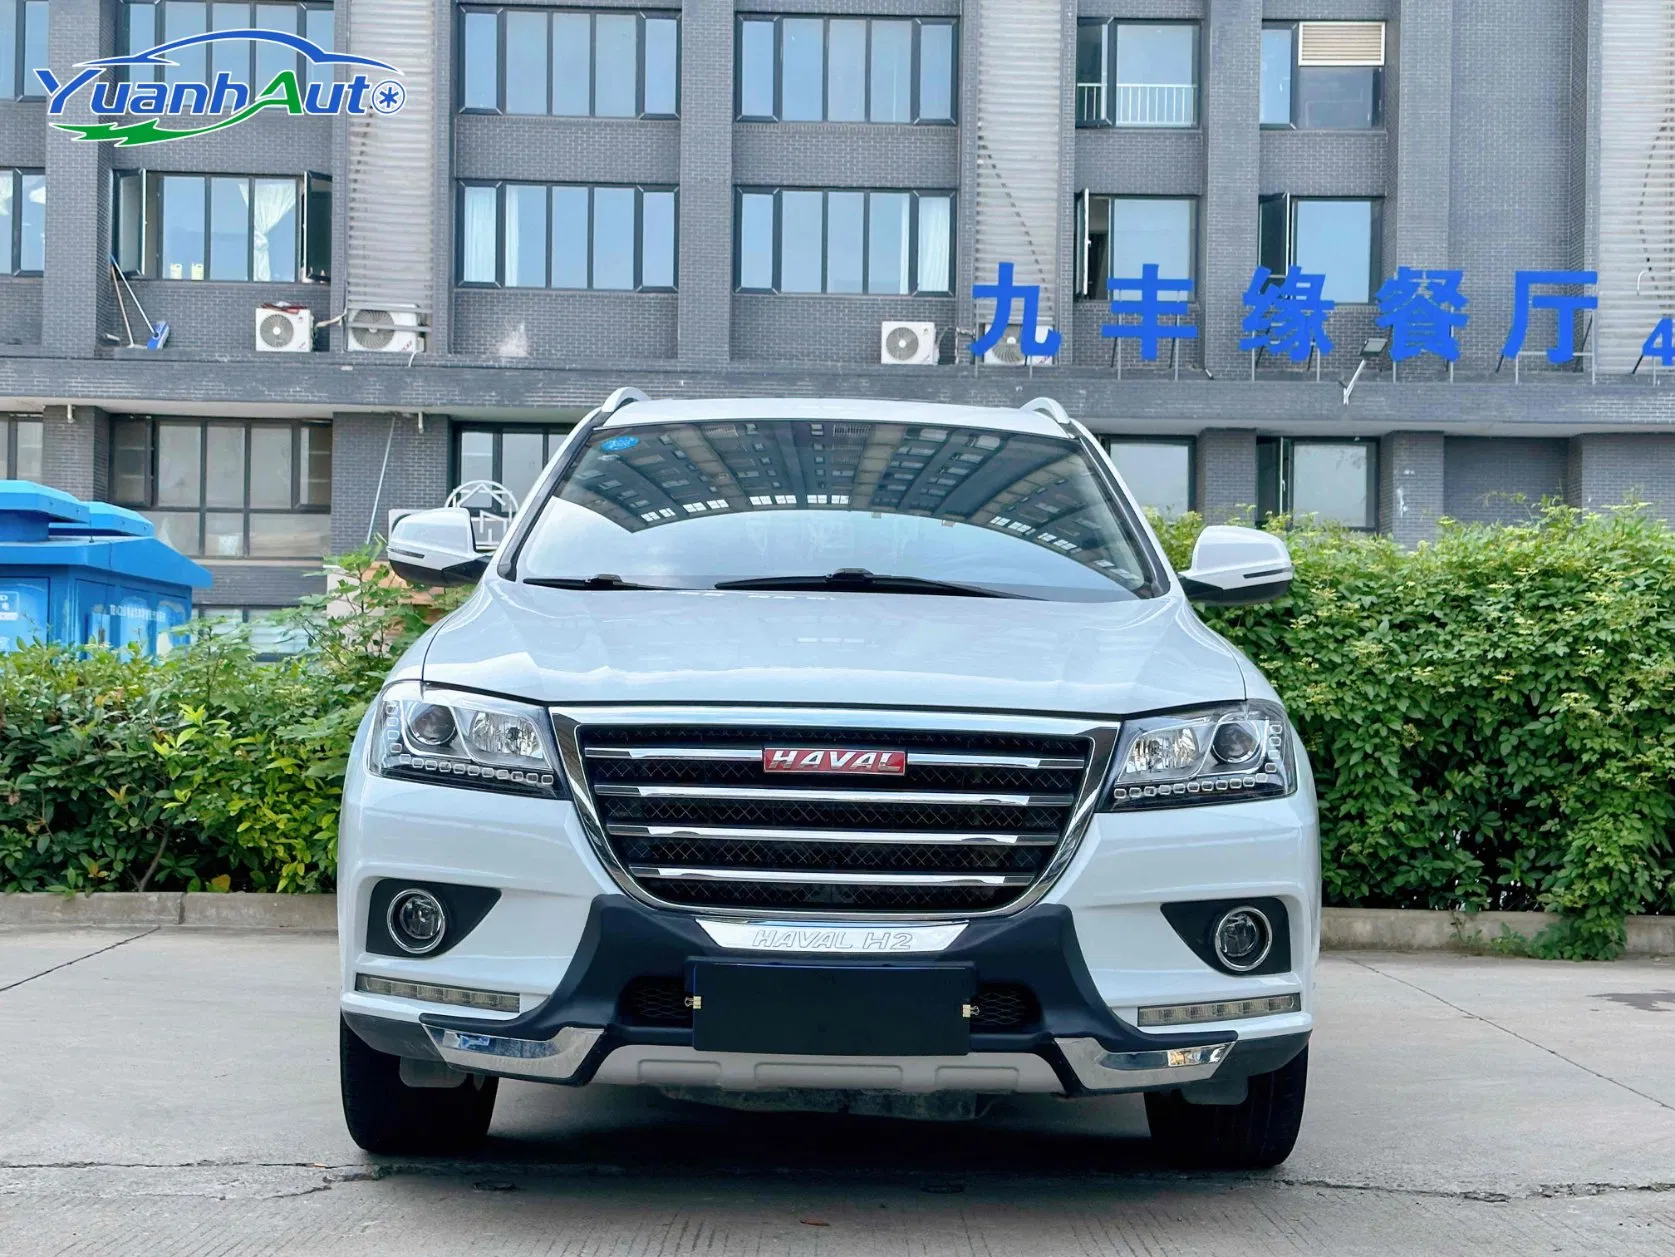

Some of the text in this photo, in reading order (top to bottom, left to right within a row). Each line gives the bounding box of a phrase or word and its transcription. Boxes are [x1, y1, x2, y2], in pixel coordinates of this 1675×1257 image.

[971, 262, 1598, 362] 九丰缘餐厅
[769, 750, 900, 772] HAVAL
[752, 929, 913, 950] HAVAL H2
